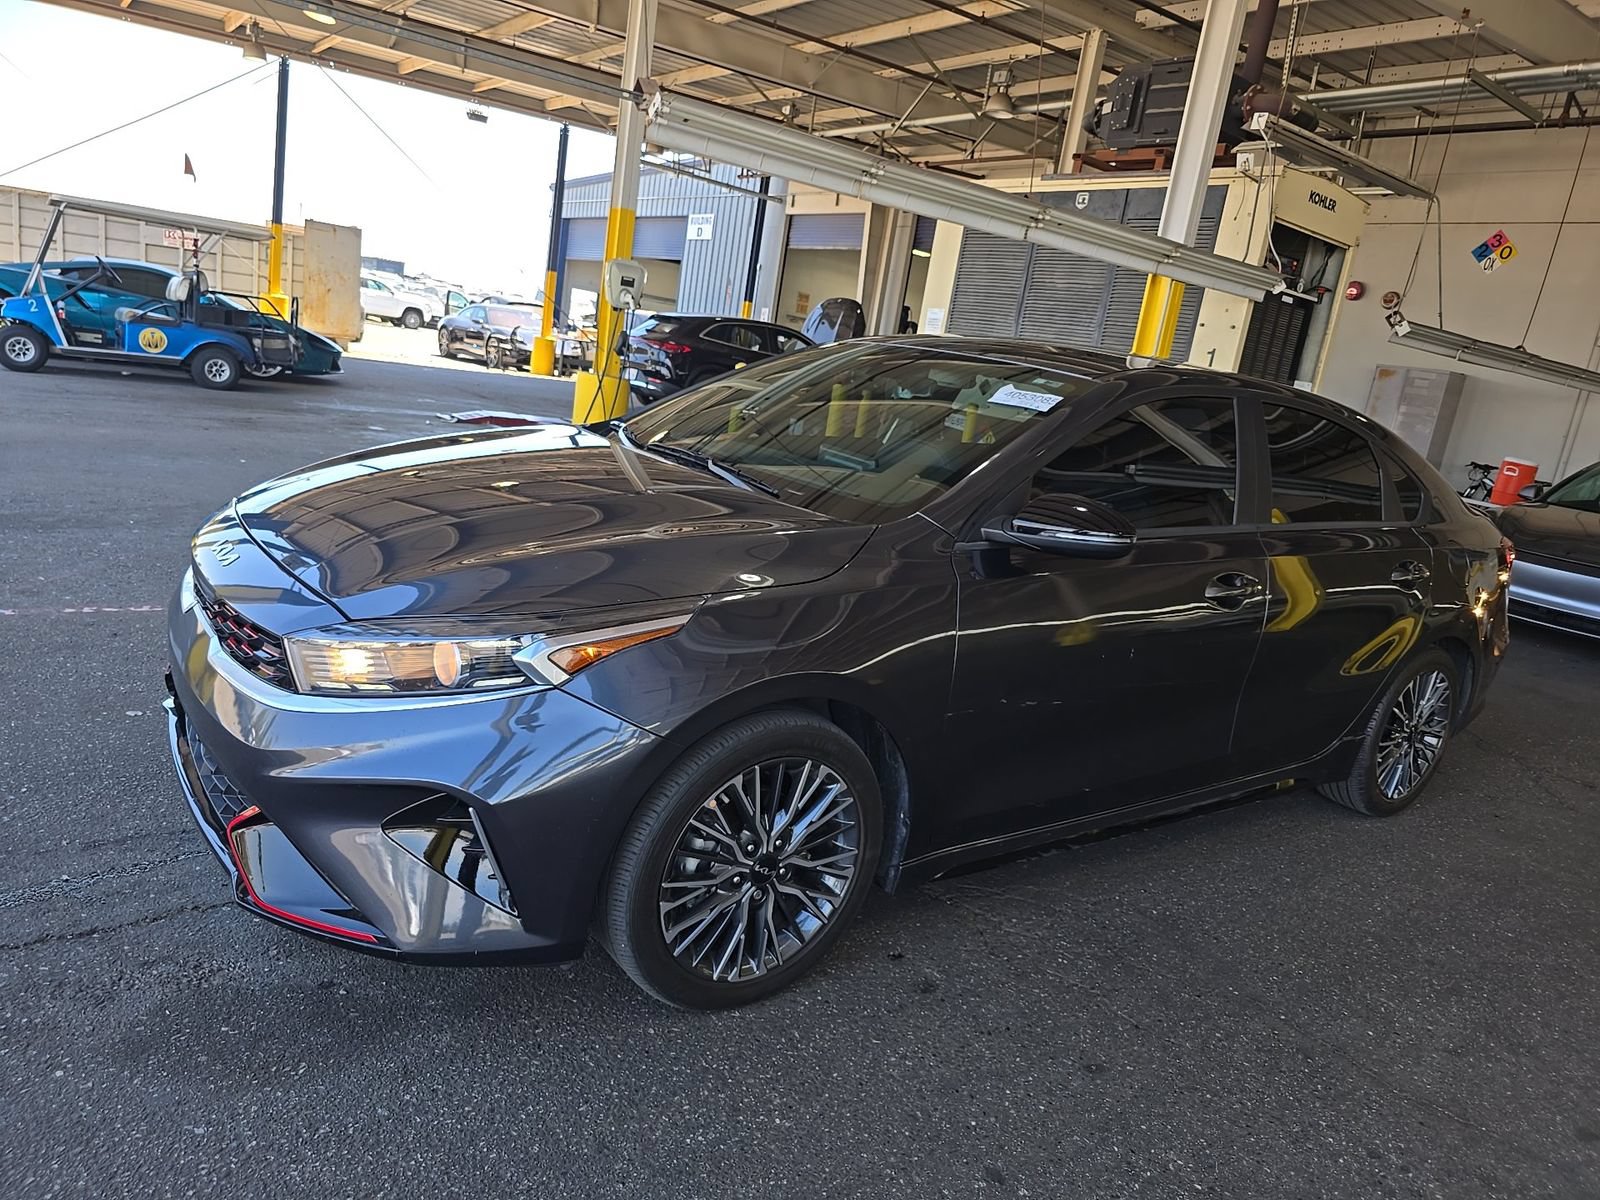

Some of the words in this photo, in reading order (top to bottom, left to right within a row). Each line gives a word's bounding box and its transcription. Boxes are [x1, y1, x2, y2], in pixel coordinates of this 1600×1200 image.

[1308, 190, 1337, 213] KOHLER
[696, 227, 703, 237] D
[1491, 234, 1503, 248] 3
[1477, 243, 1489, 258] 2
[1499, 245, 1513, 260] 0
[28, 299, 39, 312] 2
[1207, 348, 1217, 367] 1
